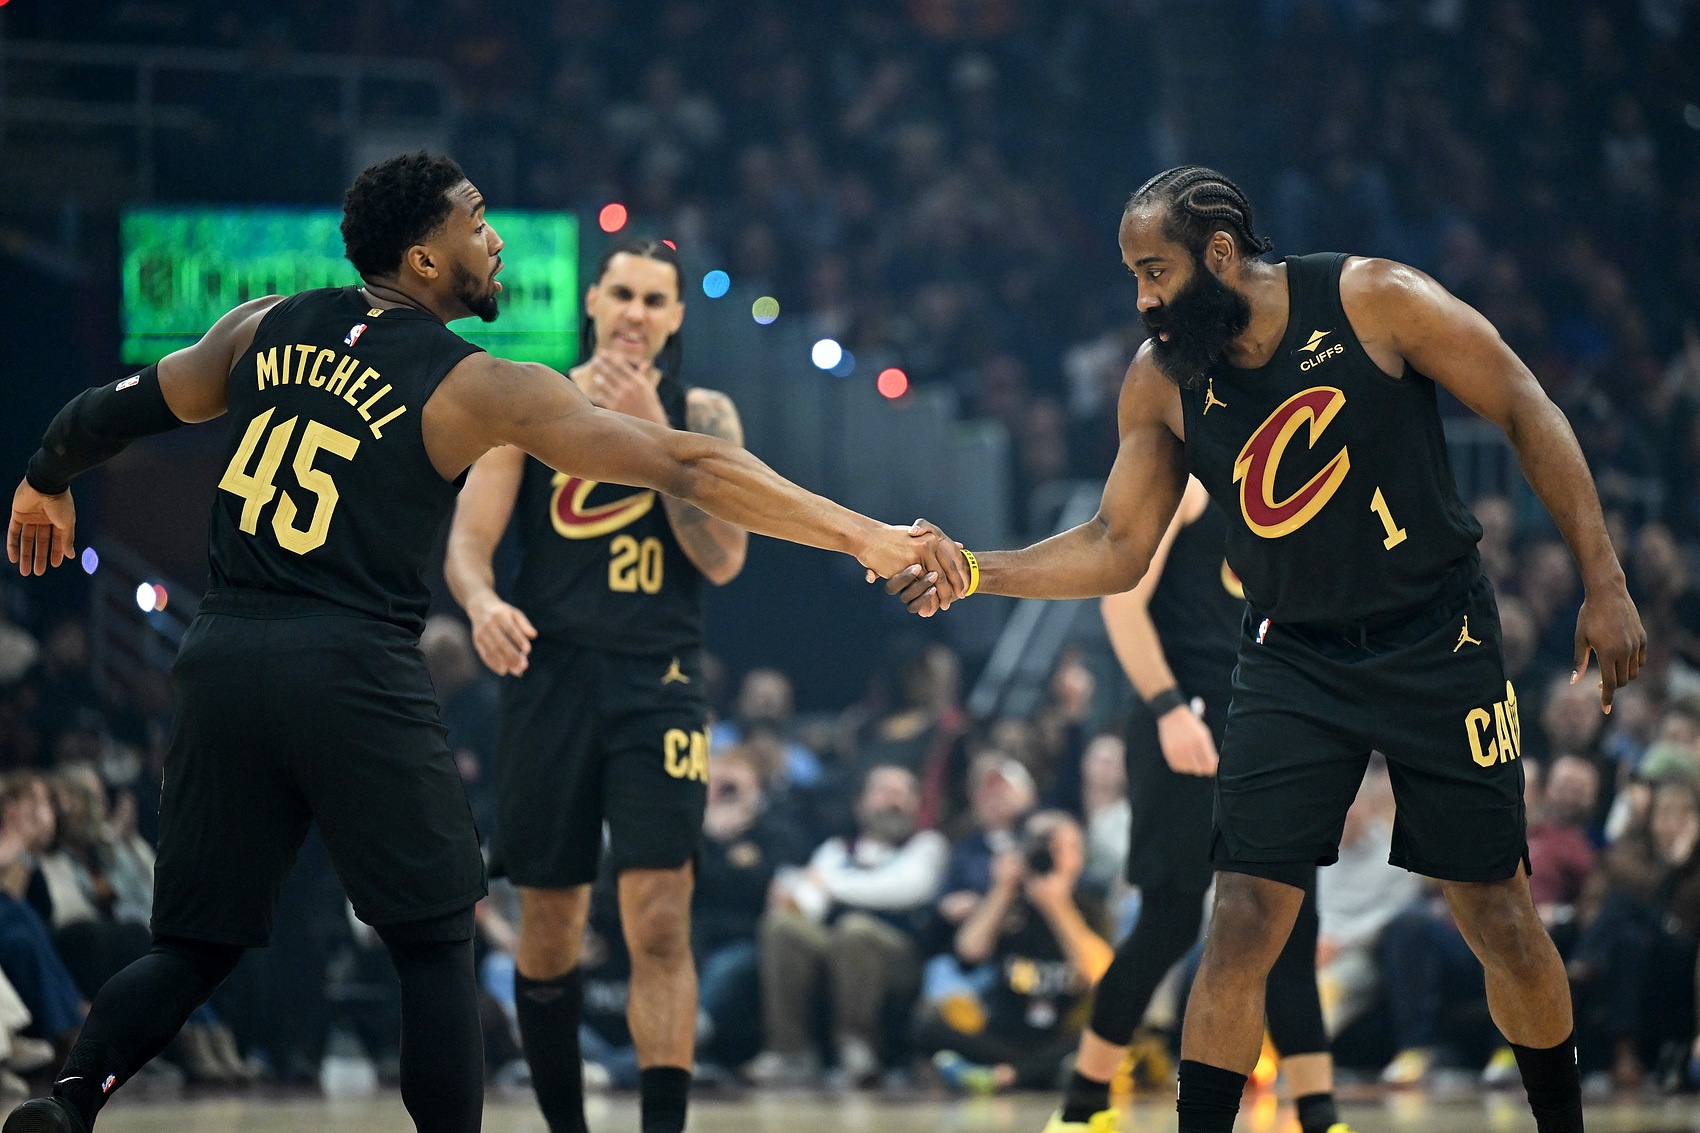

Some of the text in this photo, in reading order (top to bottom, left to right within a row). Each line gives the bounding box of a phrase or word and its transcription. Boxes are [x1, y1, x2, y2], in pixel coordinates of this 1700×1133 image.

[256, 343, 407, 440] MITCHELL
[1300, 343, 1344, 371] CLIFFS
[217, 406, 361, 555] 45
[1232, 385, 1351, 539] C
[1370, 485, 1408, 551] 1
[608, 534, 664, 594] 20
